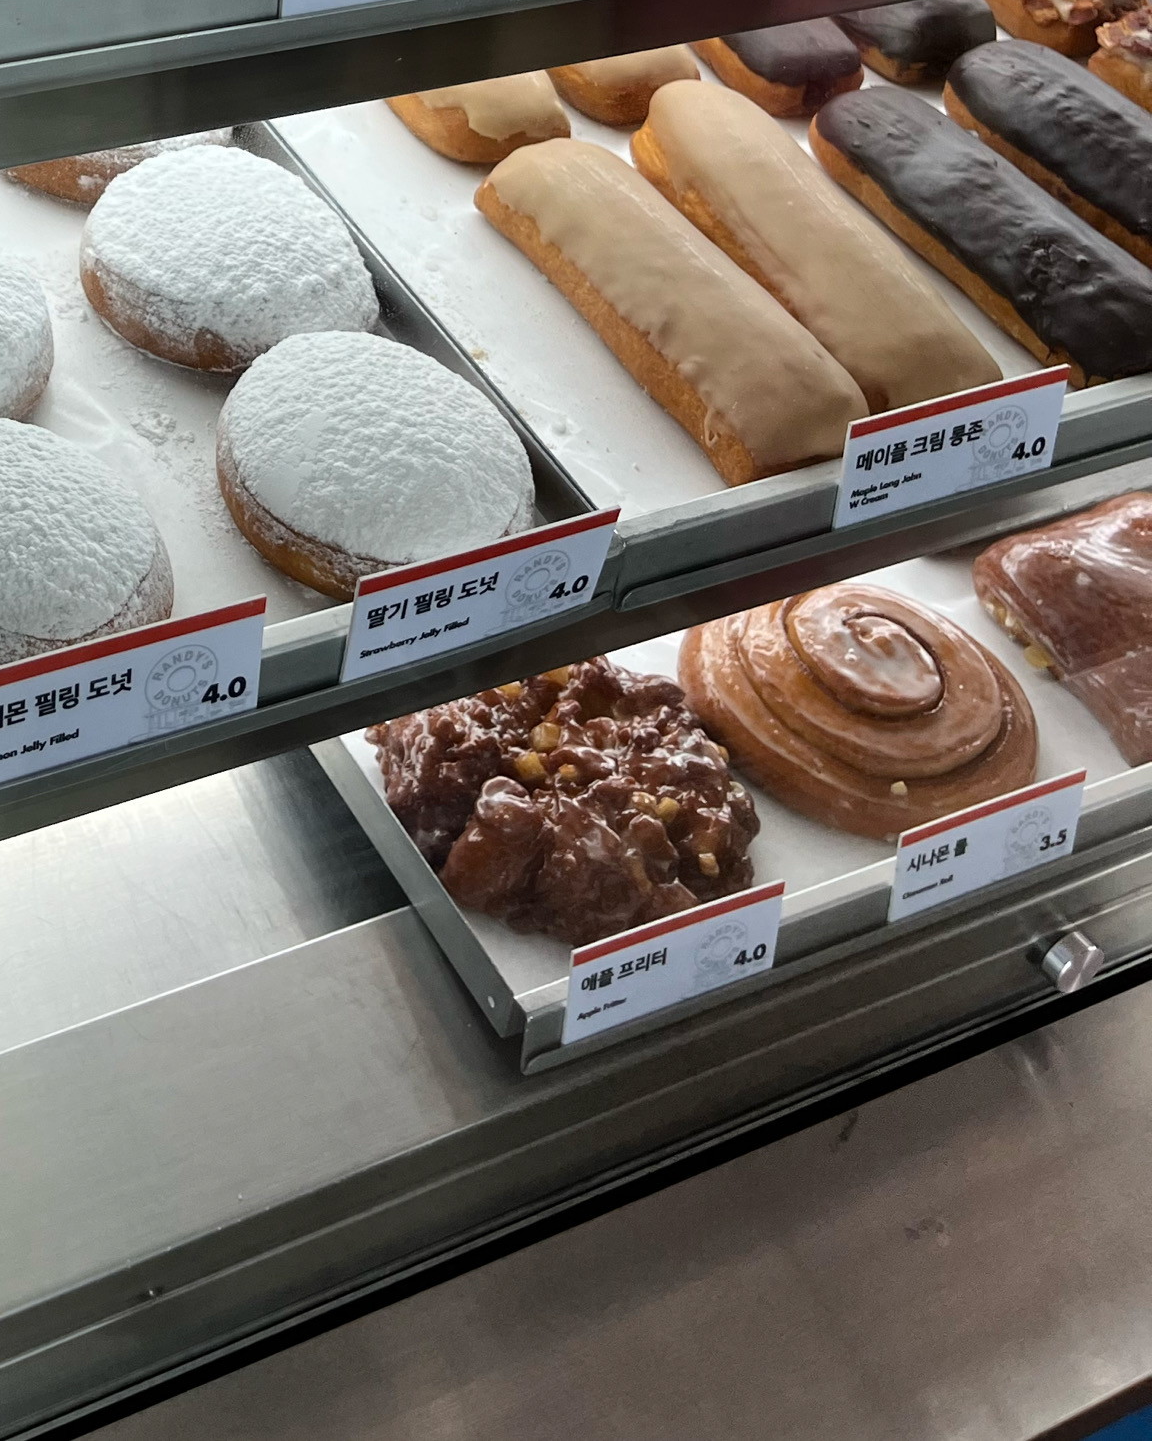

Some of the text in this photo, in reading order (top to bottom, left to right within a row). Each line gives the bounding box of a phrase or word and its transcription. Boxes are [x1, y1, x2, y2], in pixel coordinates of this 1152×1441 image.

[856, 419, 984, 471] 메이플 크림 롱존
[1011, 436, 1046, 461] 4.0
[851, 484, 877, 498] Maple
[879, 479, 900, 490] Long
[849, 500, 859, 509] W
[367, 571, 500, 629] 딸기 필링 도넛
[549, 575, 589, 599] 4.0
[359, 617, 470, 659] Strawberry Jelly Filled
[152, 650, 214, 682] RANDY'S
[35, 683, 80, 716] 필링
[86, 668, 132, 701] 도넛
[153, 678, 207, 705] DONUTS
[201, 676, 247, 704] 4.0
[20, 738, 47, 755] Jelly
[49, 728, 79, 746] Filled
[1039, 829, 1067, 851] 3.5
[906, 844, 950, 872] 시나몬
[734, 943, 767, 965] 4.0
[581, 967, 614, 991] 애플
[617, 947, 667, 979] 프리터
